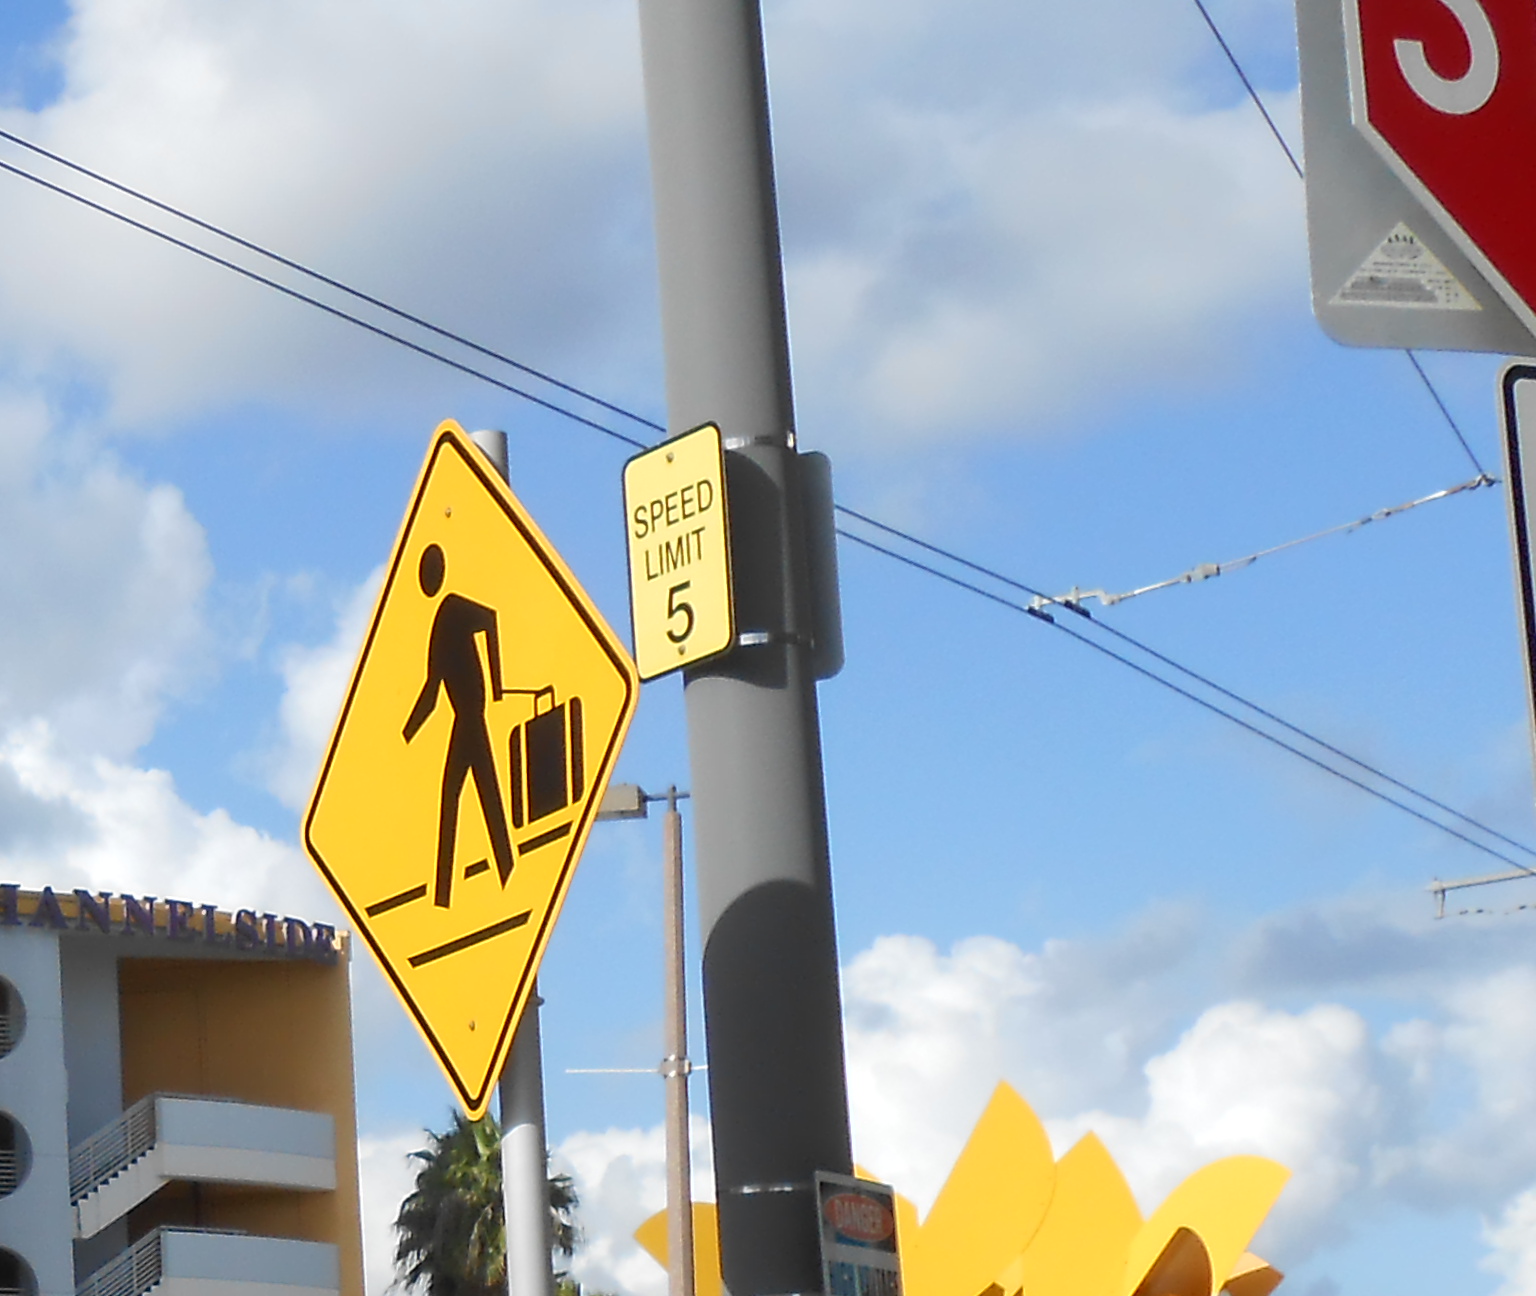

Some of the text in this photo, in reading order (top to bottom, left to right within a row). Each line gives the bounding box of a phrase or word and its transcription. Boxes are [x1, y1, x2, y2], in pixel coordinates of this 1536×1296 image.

[633, 478, 714, 540] SPEED
[644, 526, 706, 582] LIMIT
[665, 580, 695, 644] 5
[834, 1198, 884, 1234] DANGER
